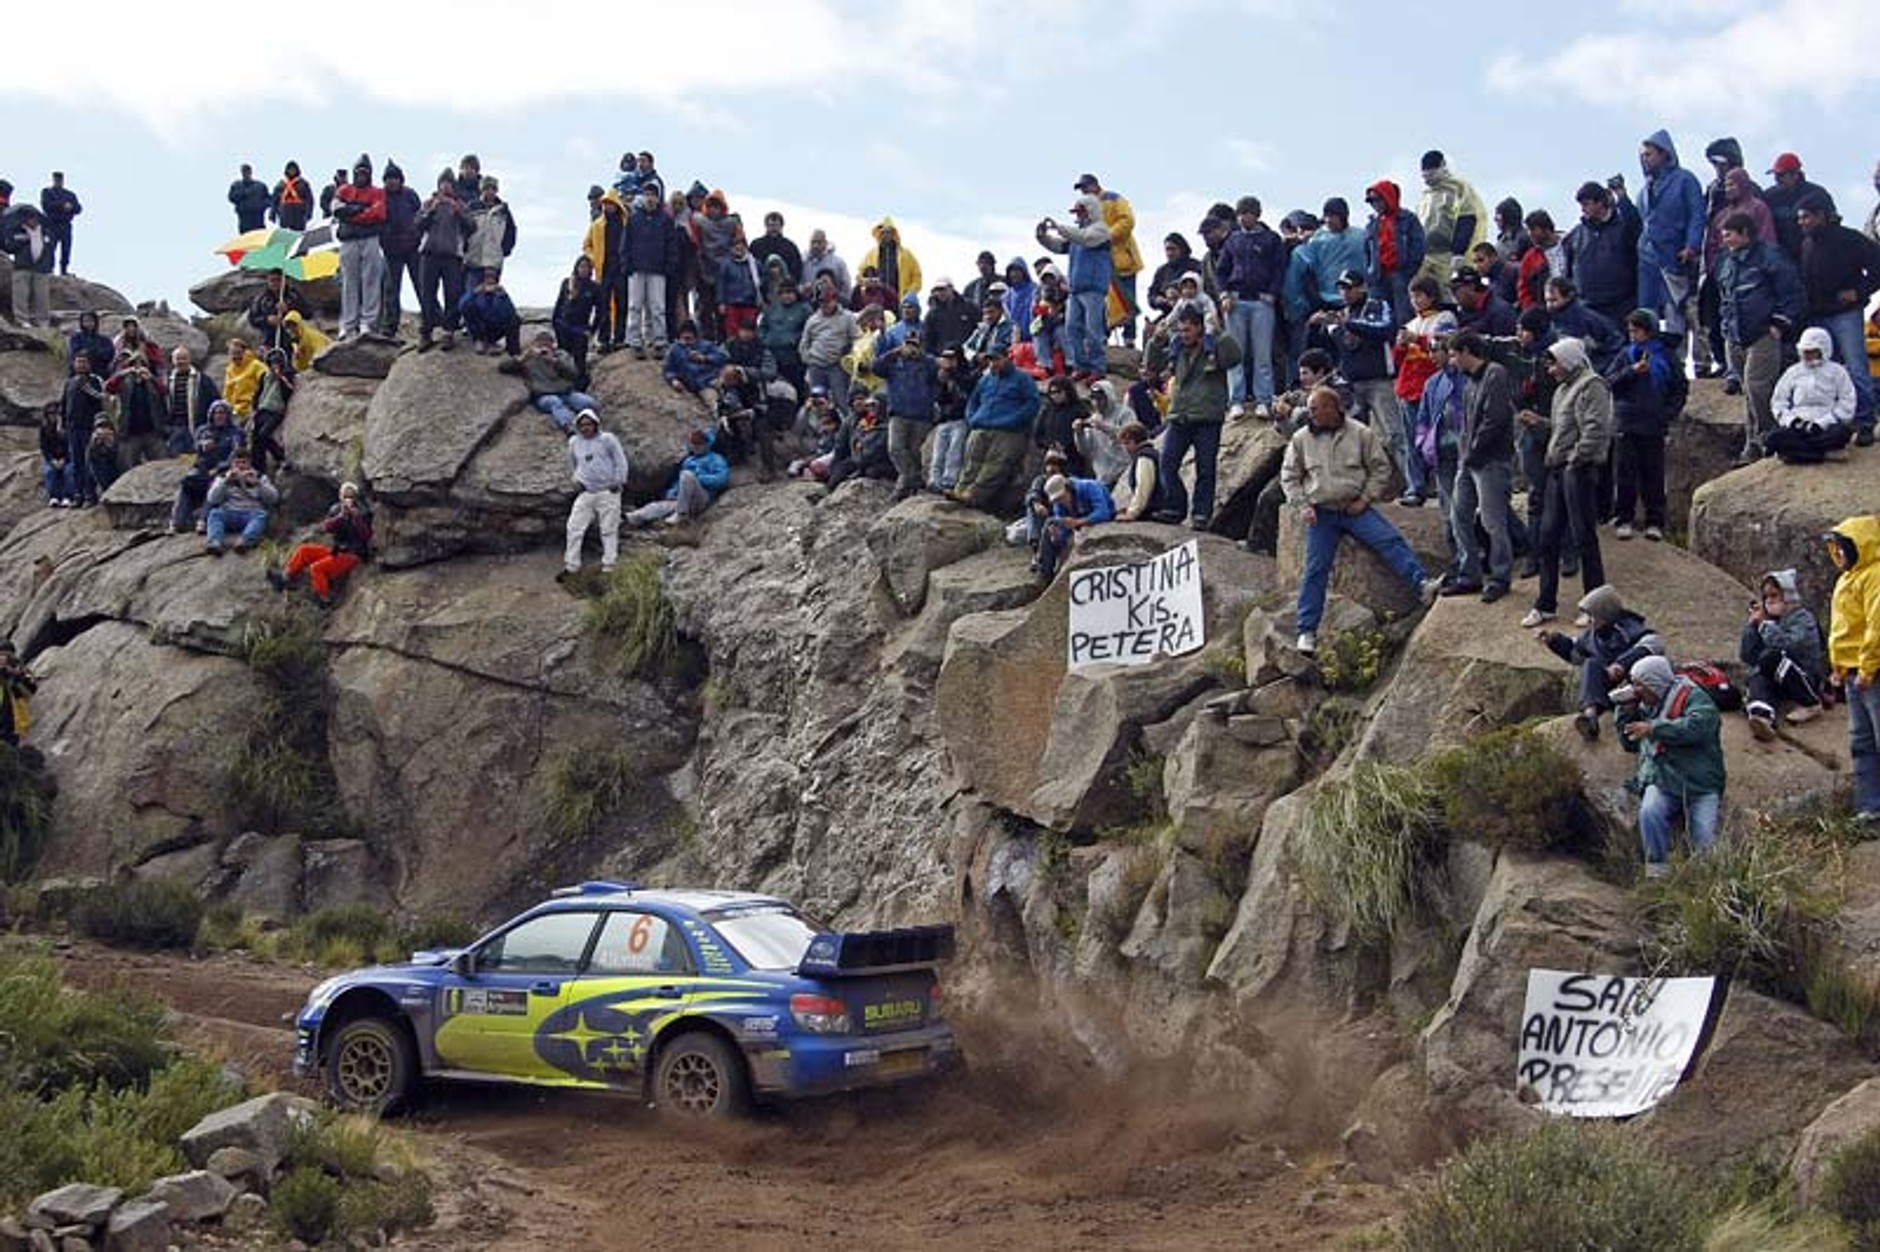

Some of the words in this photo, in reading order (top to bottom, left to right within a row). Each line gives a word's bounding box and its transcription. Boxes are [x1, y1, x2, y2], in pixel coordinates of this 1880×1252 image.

[1071, 546, 1194, 605] CRISTINA
[1071, 615, 1194, 663] PETERA
[629, 914, 653, 954] 6
[864, 1000, 920, 1021] SUBARU
[1553, 974, 1667, 1017] SAN
[1522, 1013, 1688, 1060] ANTONIO
